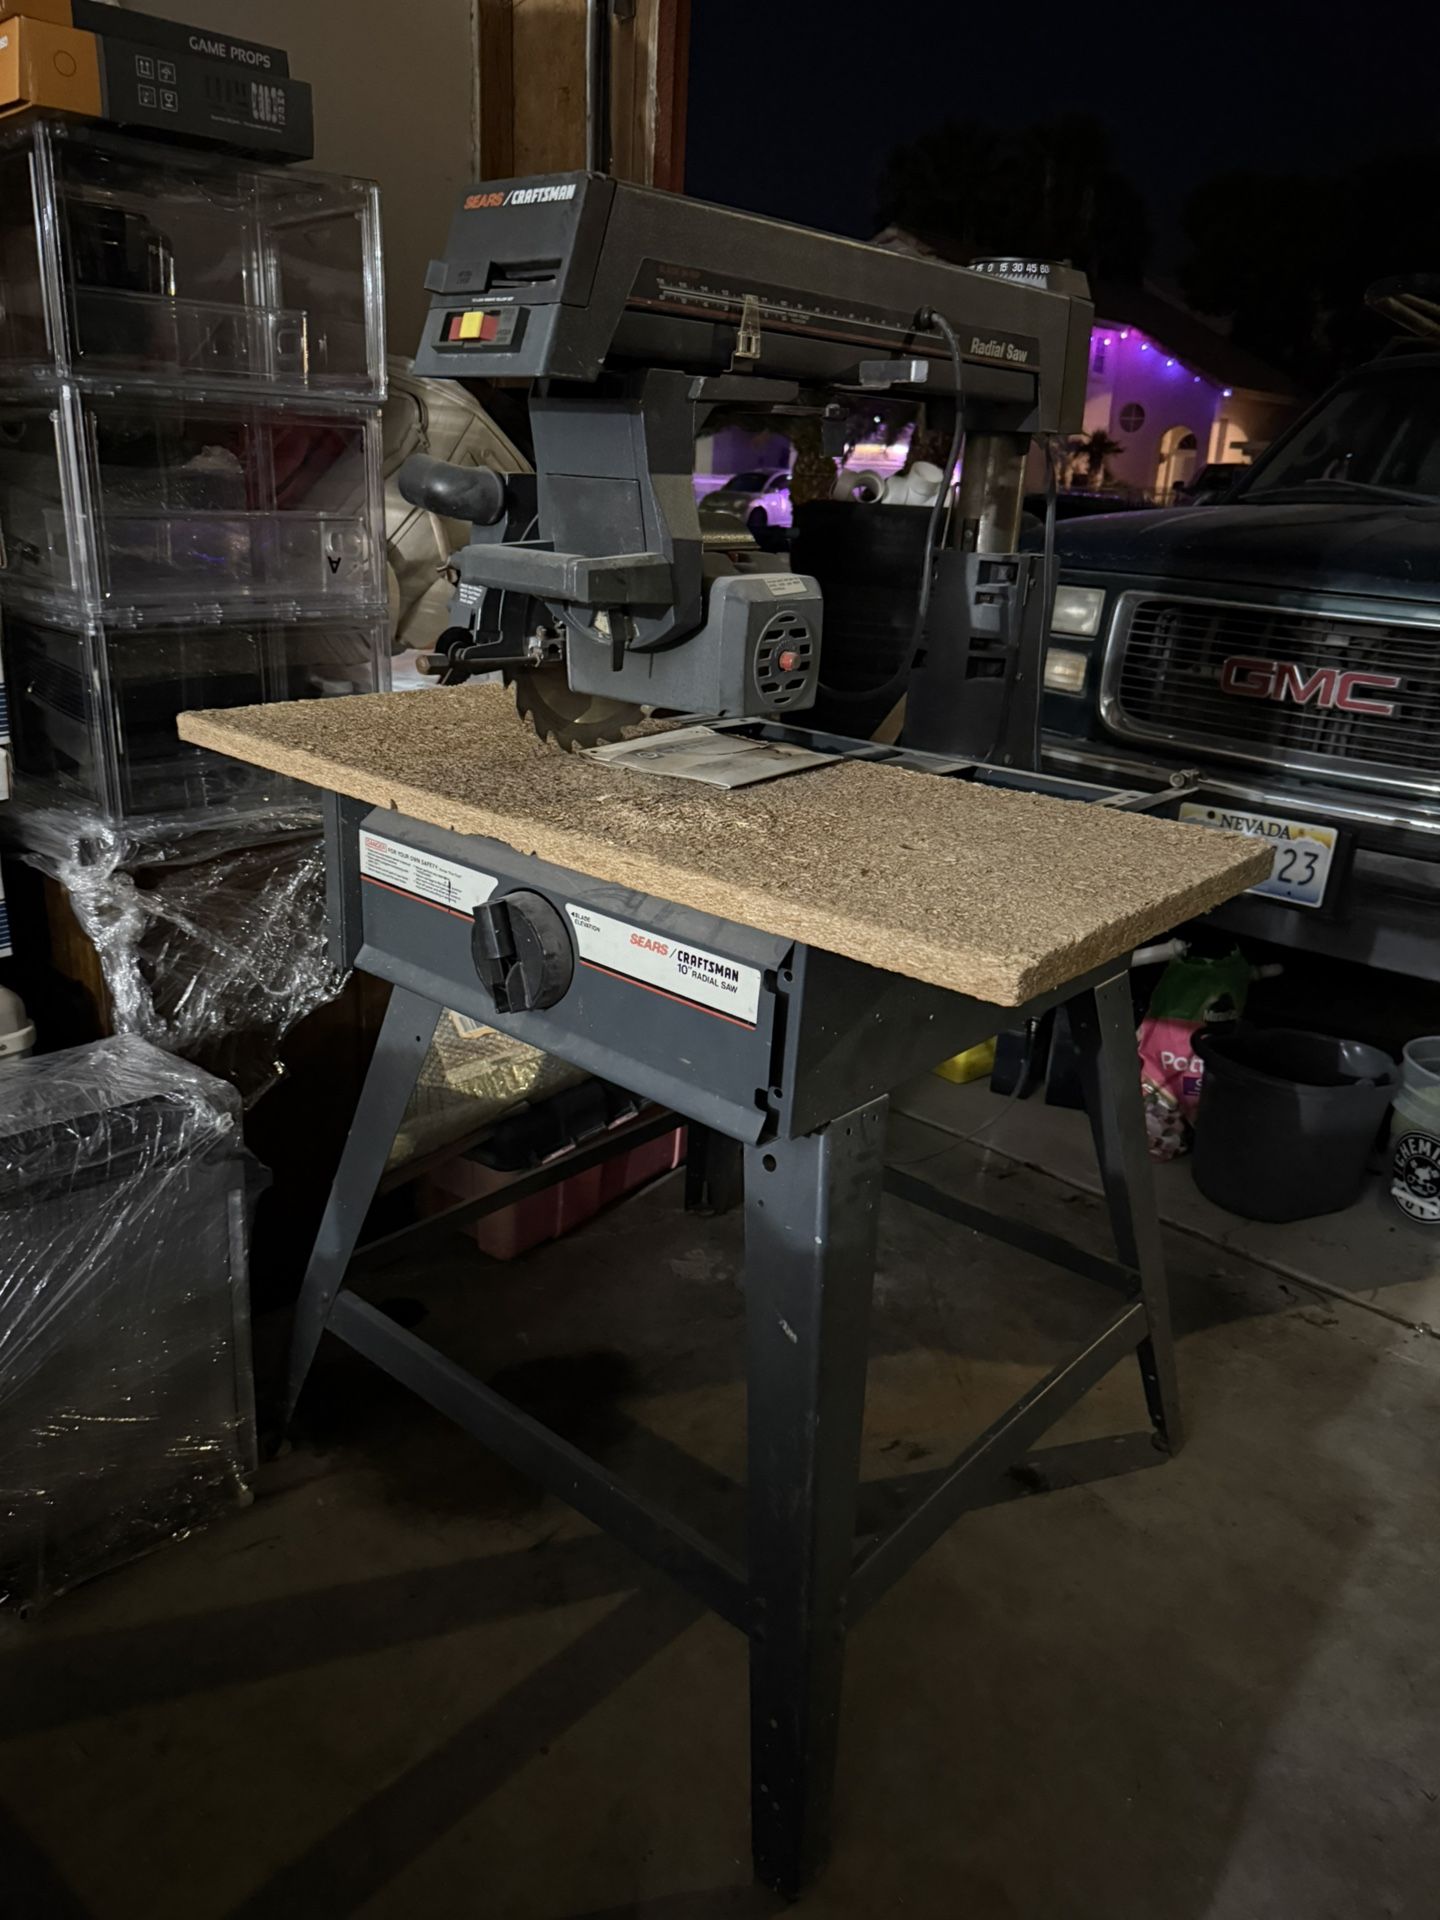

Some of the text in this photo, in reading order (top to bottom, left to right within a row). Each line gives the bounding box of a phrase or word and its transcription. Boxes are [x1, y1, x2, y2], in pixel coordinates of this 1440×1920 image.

[189, 36, 271, 68] GAME PROPS
[1000, 263, 1008, 272] 15
[1012, 263, 1023, 272] 30
[1026, 264, 1037, 273] 45
[1040, 265, 1050, 274] 60
[970, 337, 1028, 362] Radial Saw
[1220, 655, 1401, 716] GMC
[1220, 814, 1291, 840] NEVADA
[1271, 846, 1319, 886] 23
[574, 919, 600, 932] ELEVATION
[692, 969, 719, 987] RADIAL
[721, 980, 738, 994] SAW
[1394, 1138, 1440, 1168] CHEMI
